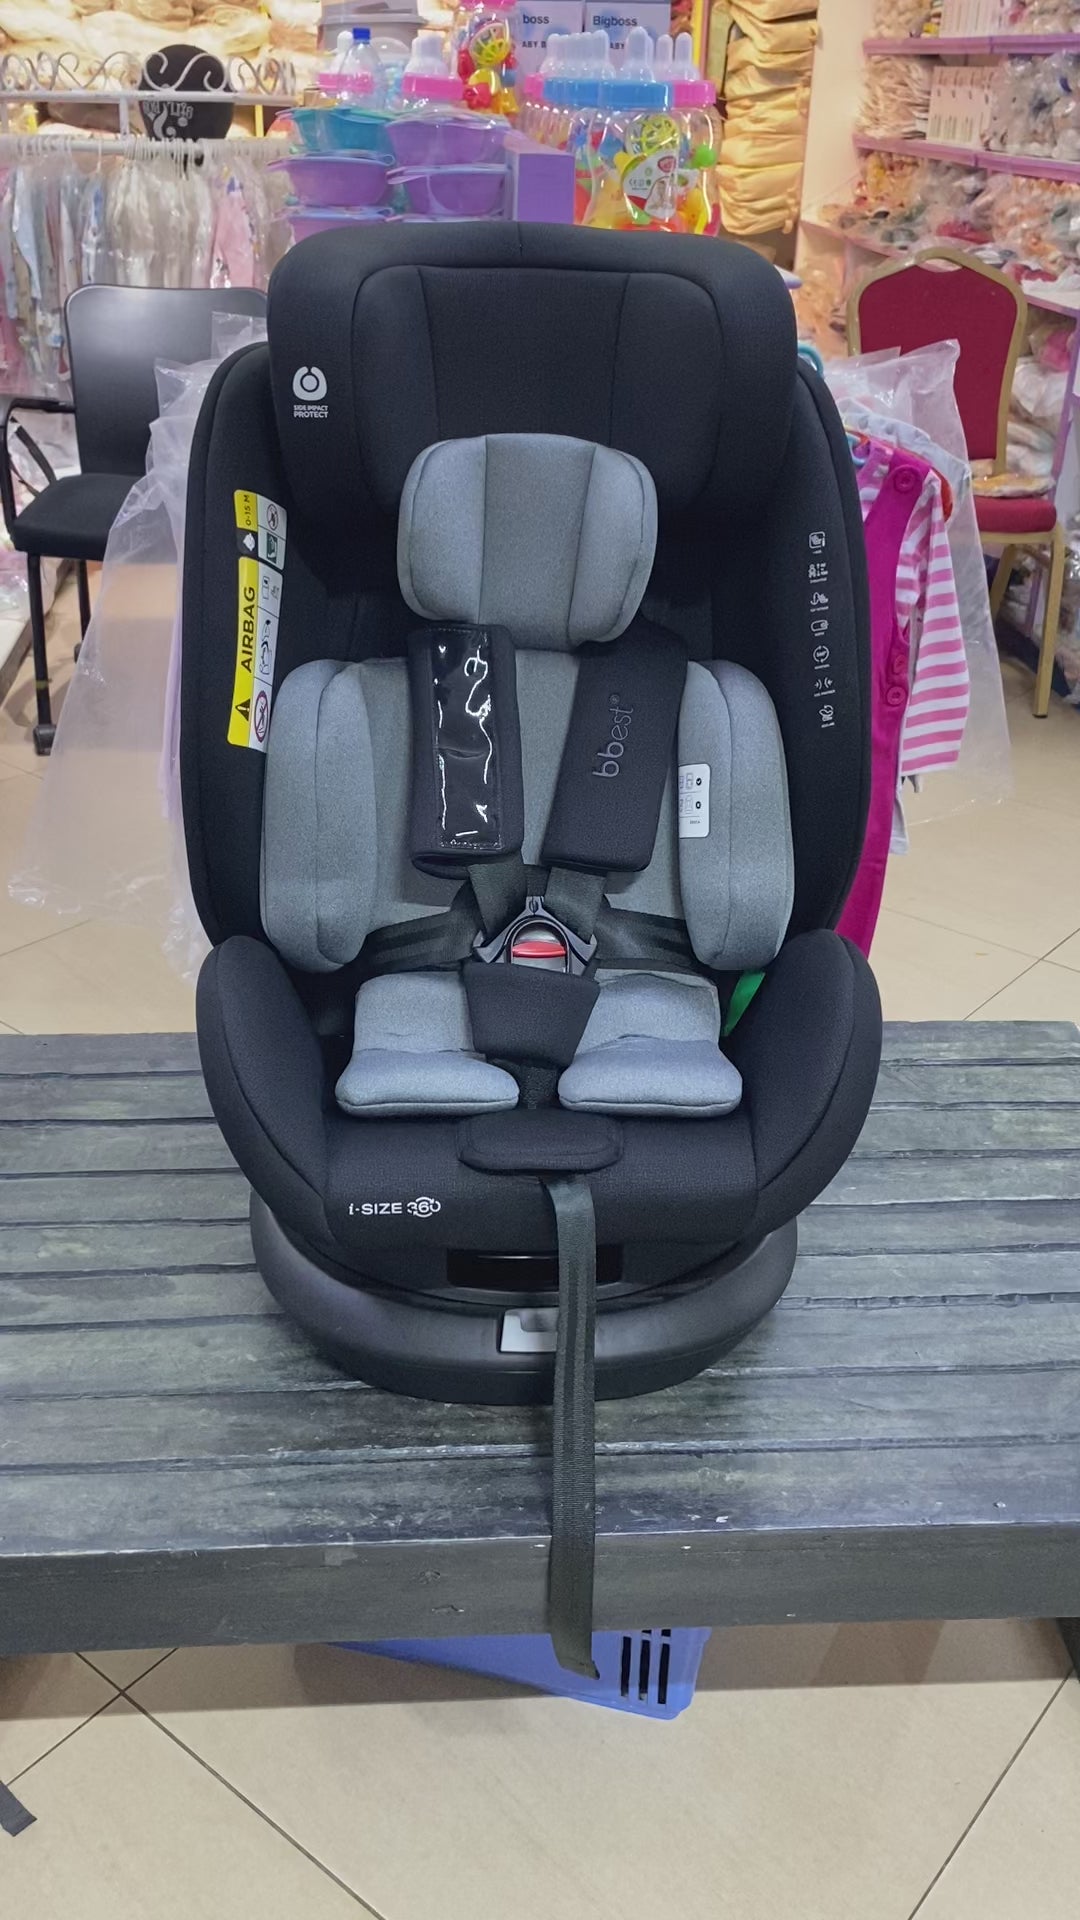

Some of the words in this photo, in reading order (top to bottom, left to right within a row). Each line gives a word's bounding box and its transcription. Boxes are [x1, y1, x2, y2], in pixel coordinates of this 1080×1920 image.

[522, 14, 550, 25] boss
[593, 15, 638, 28] Bigboss
[522, 40, 538, 48] ABY
[240, 586, 256, 674] AIRBAG
[348, 1202, 403, 1215] i-SIZE
[406, 1199, 442, 1215] 360
